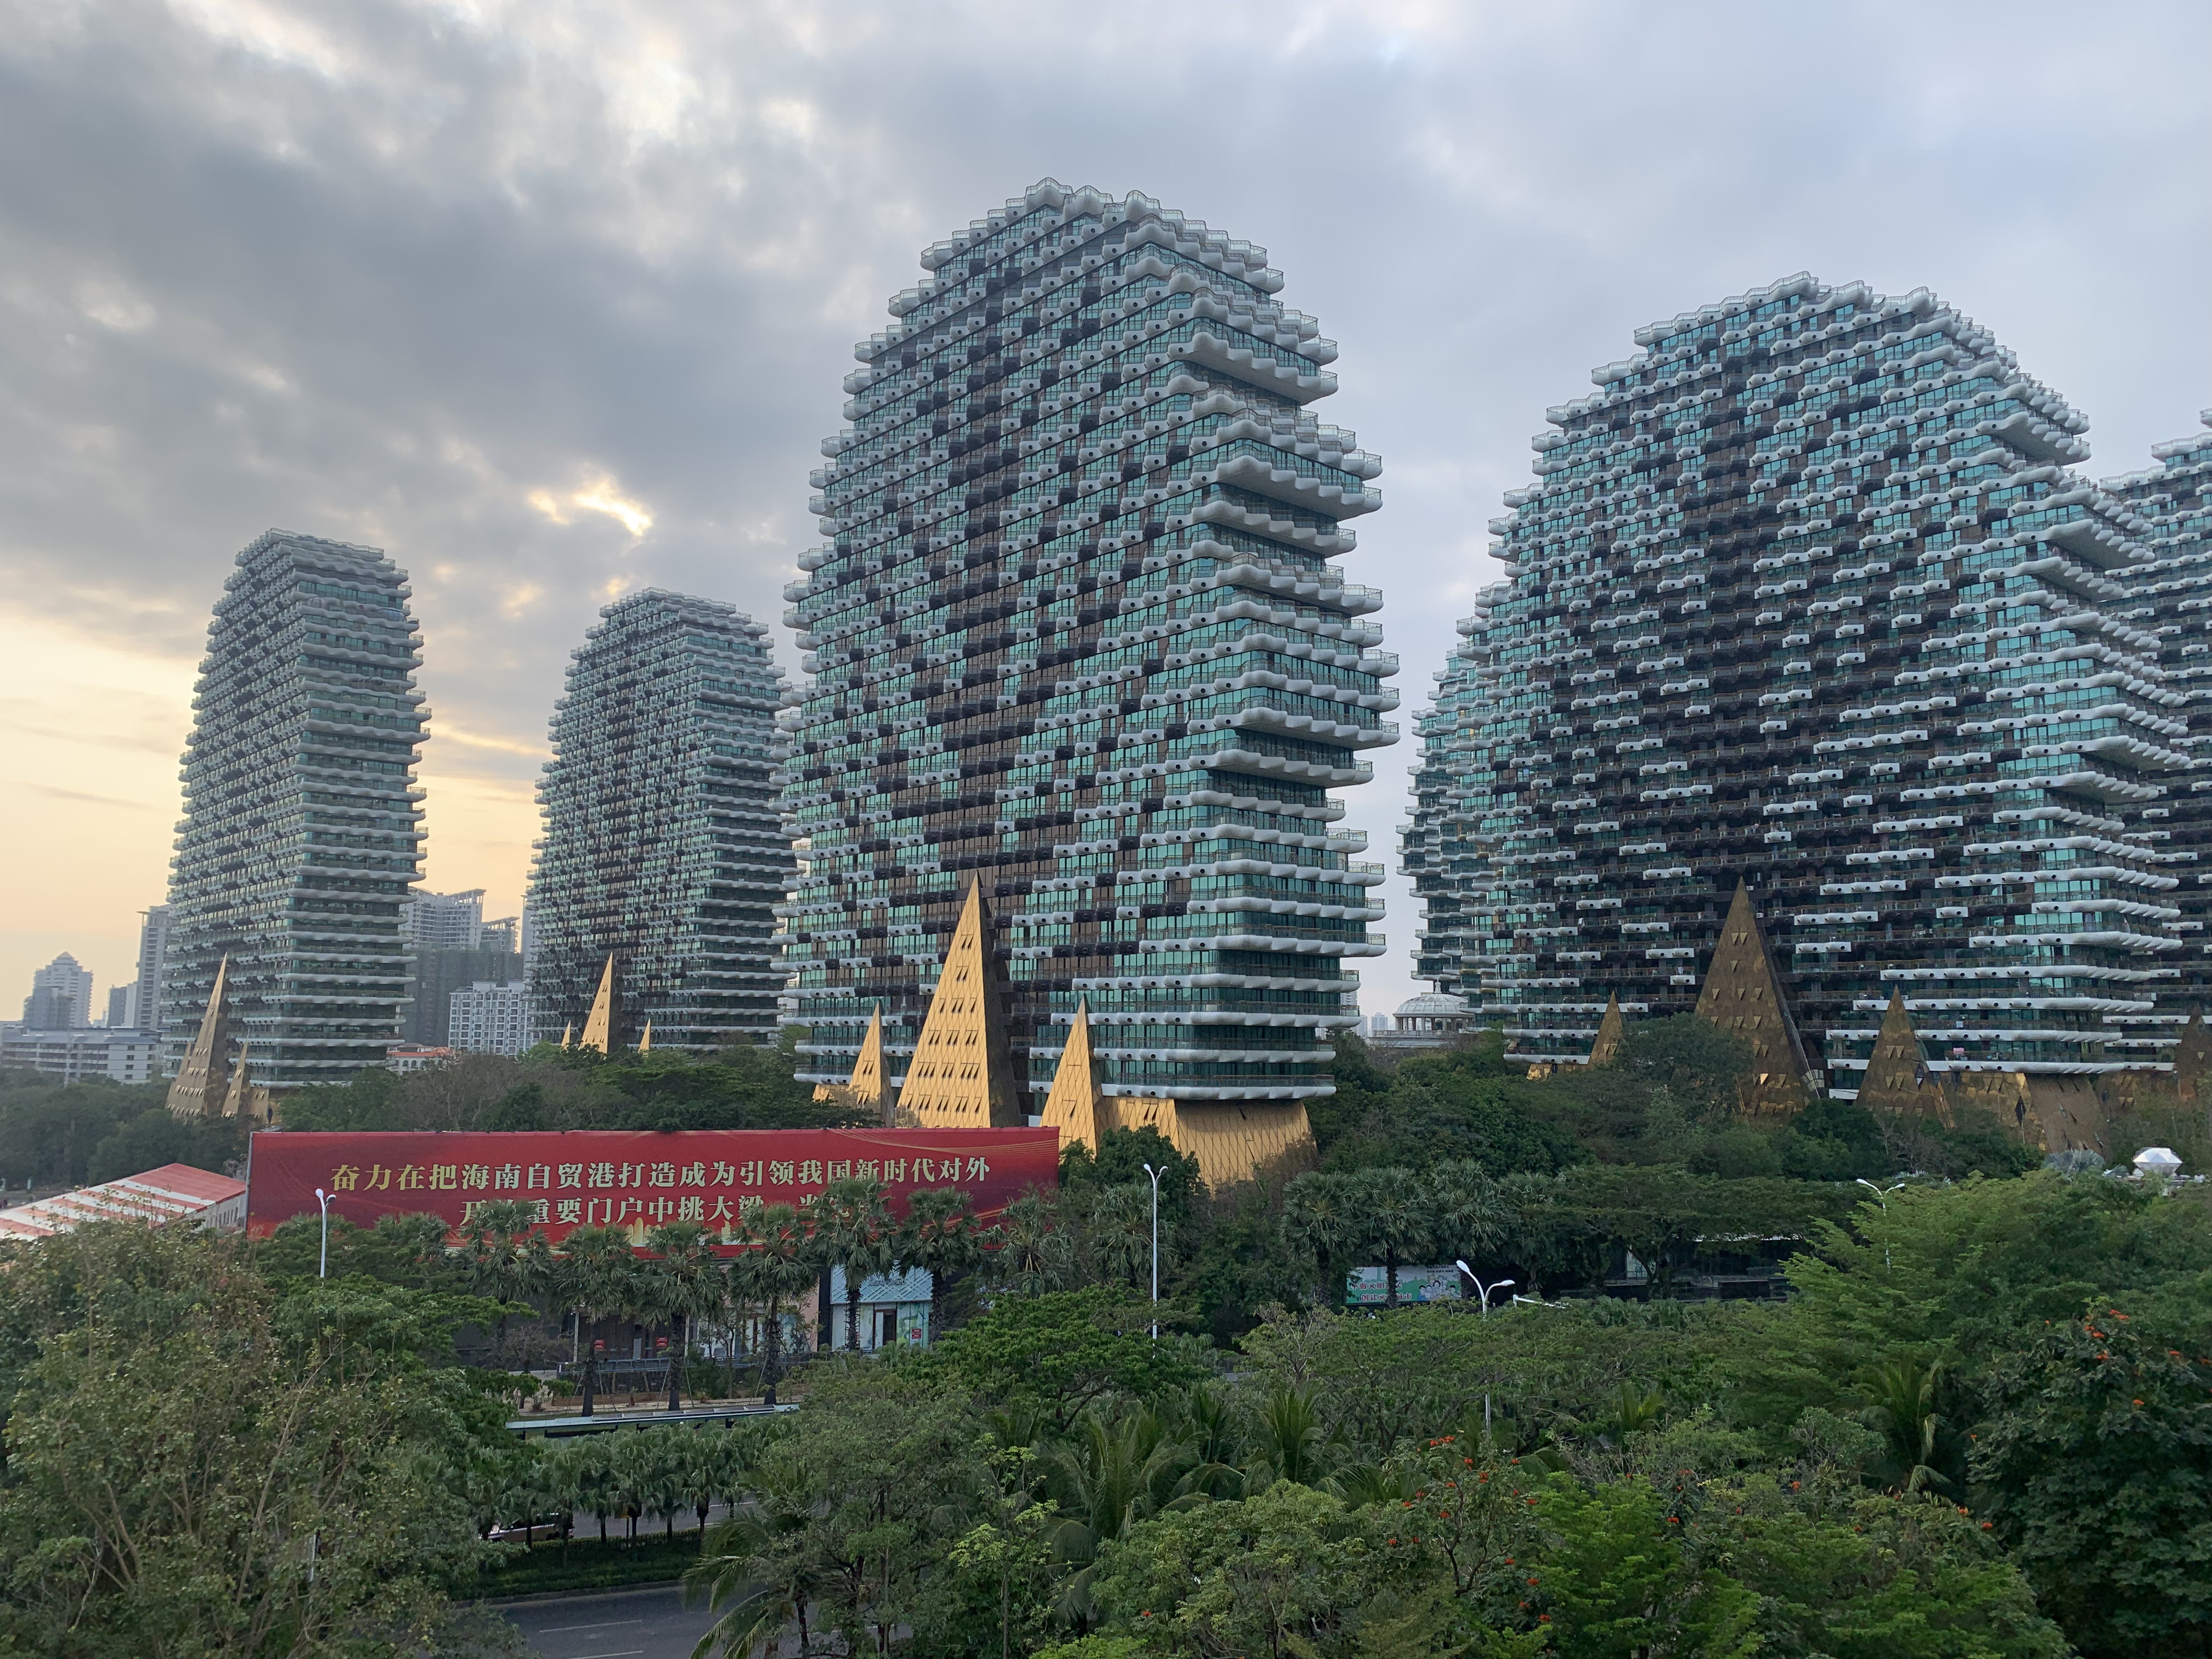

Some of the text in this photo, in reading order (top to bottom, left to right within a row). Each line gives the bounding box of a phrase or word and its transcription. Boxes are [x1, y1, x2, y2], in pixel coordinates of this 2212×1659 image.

[330, 1157, 990, 1191] 奋力在把海南自贸港打造成为引领我国新时代对外
